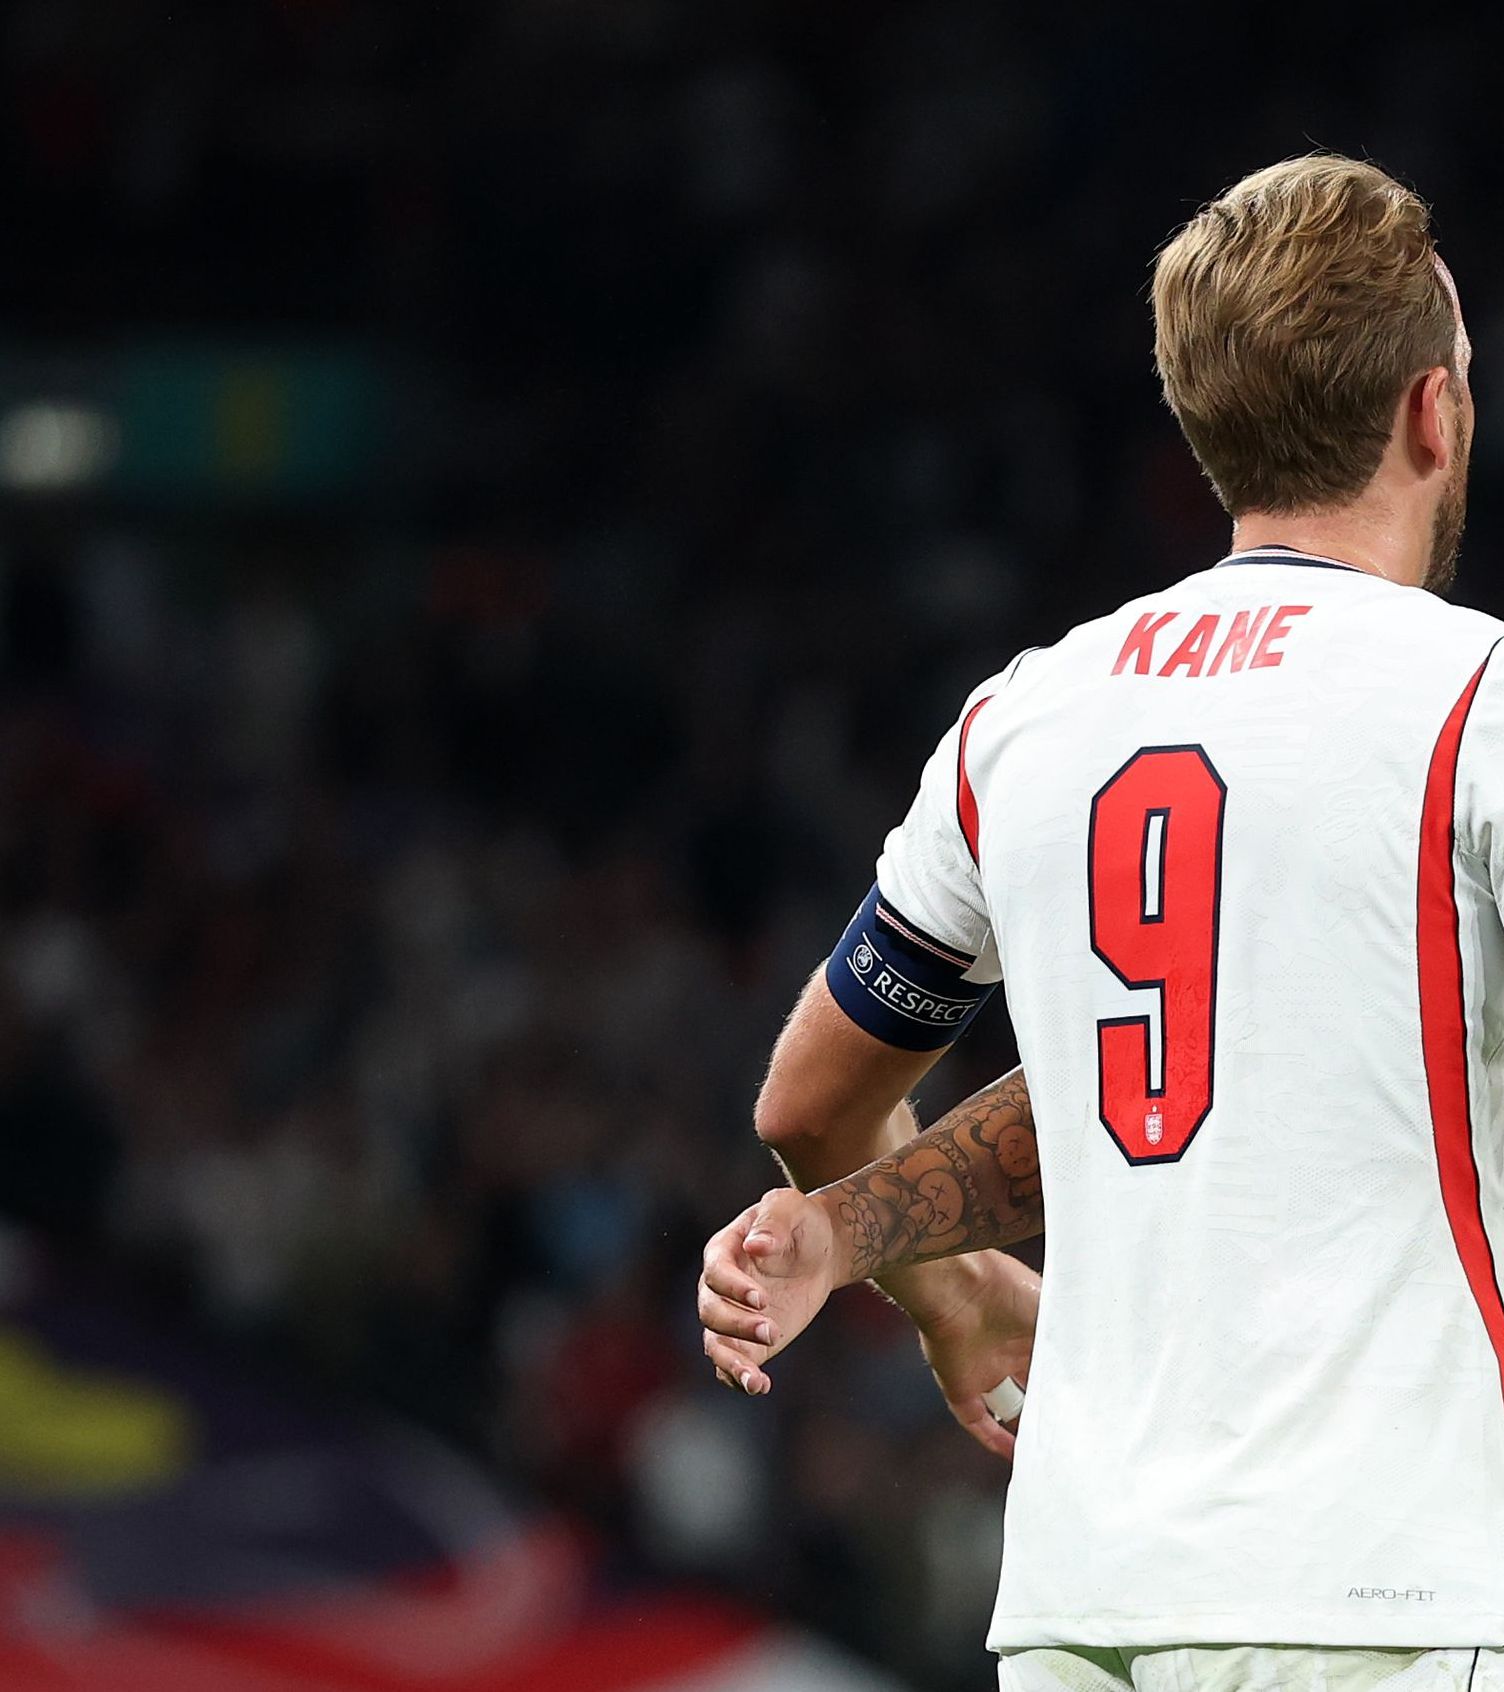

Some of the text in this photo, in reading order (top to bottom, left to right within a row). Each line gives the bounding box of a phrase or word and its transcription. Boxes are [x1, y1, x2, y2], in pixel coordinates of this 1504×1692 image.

[1110, 605, 1313, 678] KANE
[1088, 743, 1228, 1167] 9
[873, 970, 976, 1021] RESPECT
[1346, 1586, 1437, 1601] AERO-FIT
